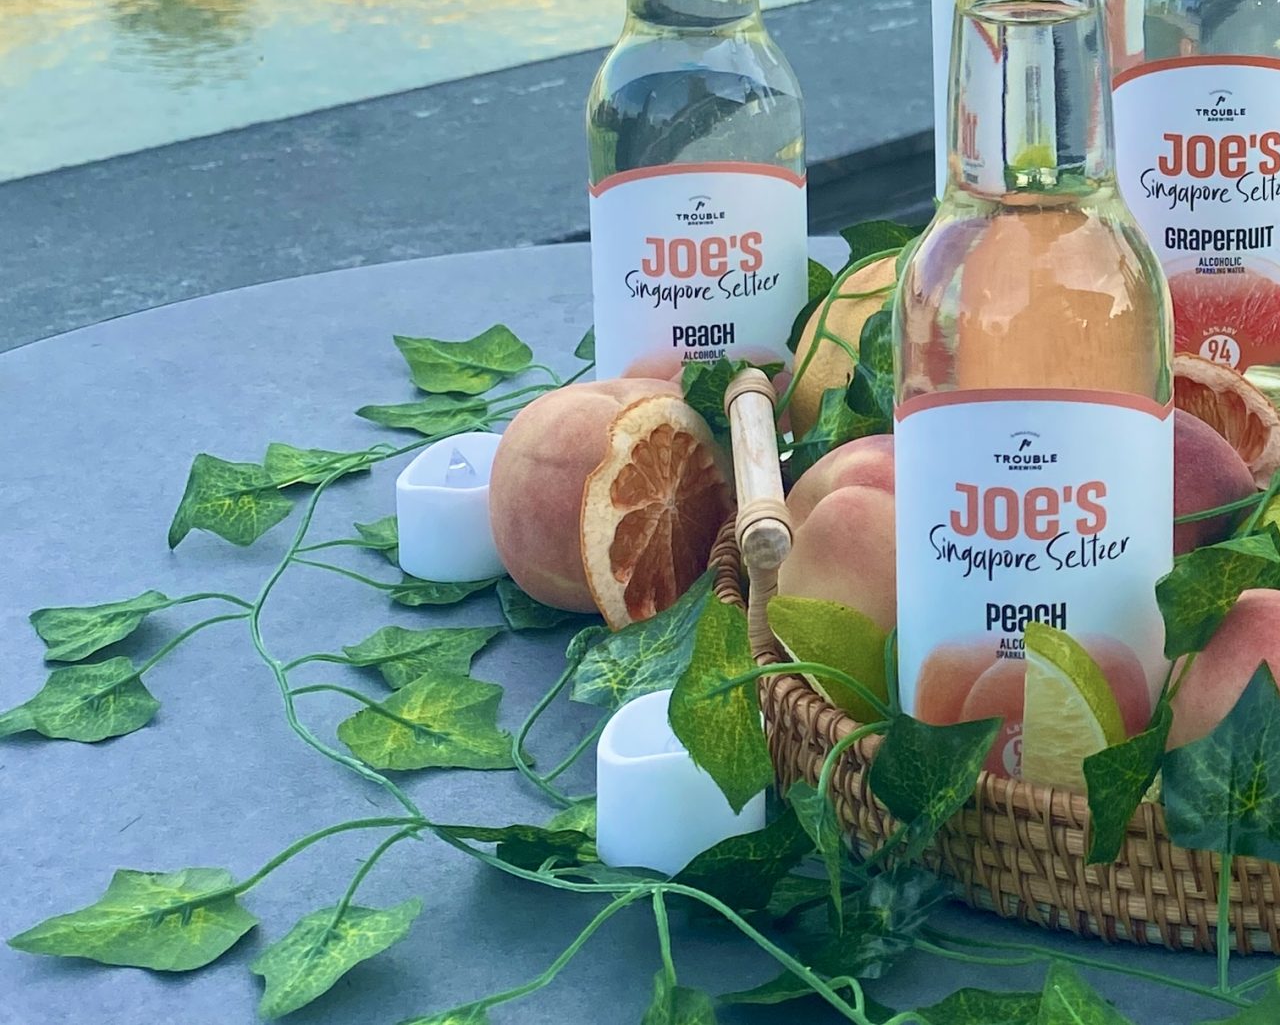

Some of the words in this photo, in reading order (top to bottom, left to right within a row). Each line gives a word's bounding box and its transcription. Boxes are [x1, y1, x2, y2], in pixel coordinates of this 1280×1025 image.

[1195, 108, 1246, 117] TROUBLE
[1140, 168, 1232, 211] Singapore
[675, 211, 725, 221] TROUBLE
[1198, 256, 1242, 267] ALCOHOLIC
[624, 269, 714, 310] Singapore
[718, 269, 780, 300] Seltzer
[683, 348, 726, 360] ALCOHOLIC
[1208, 339, 1231, 362] 94
[993, 453, 1058, 465] TROUBLE
[929, 524, 1041, 581] Singapore
[1045, 531, 1131, 572] Seltzer
